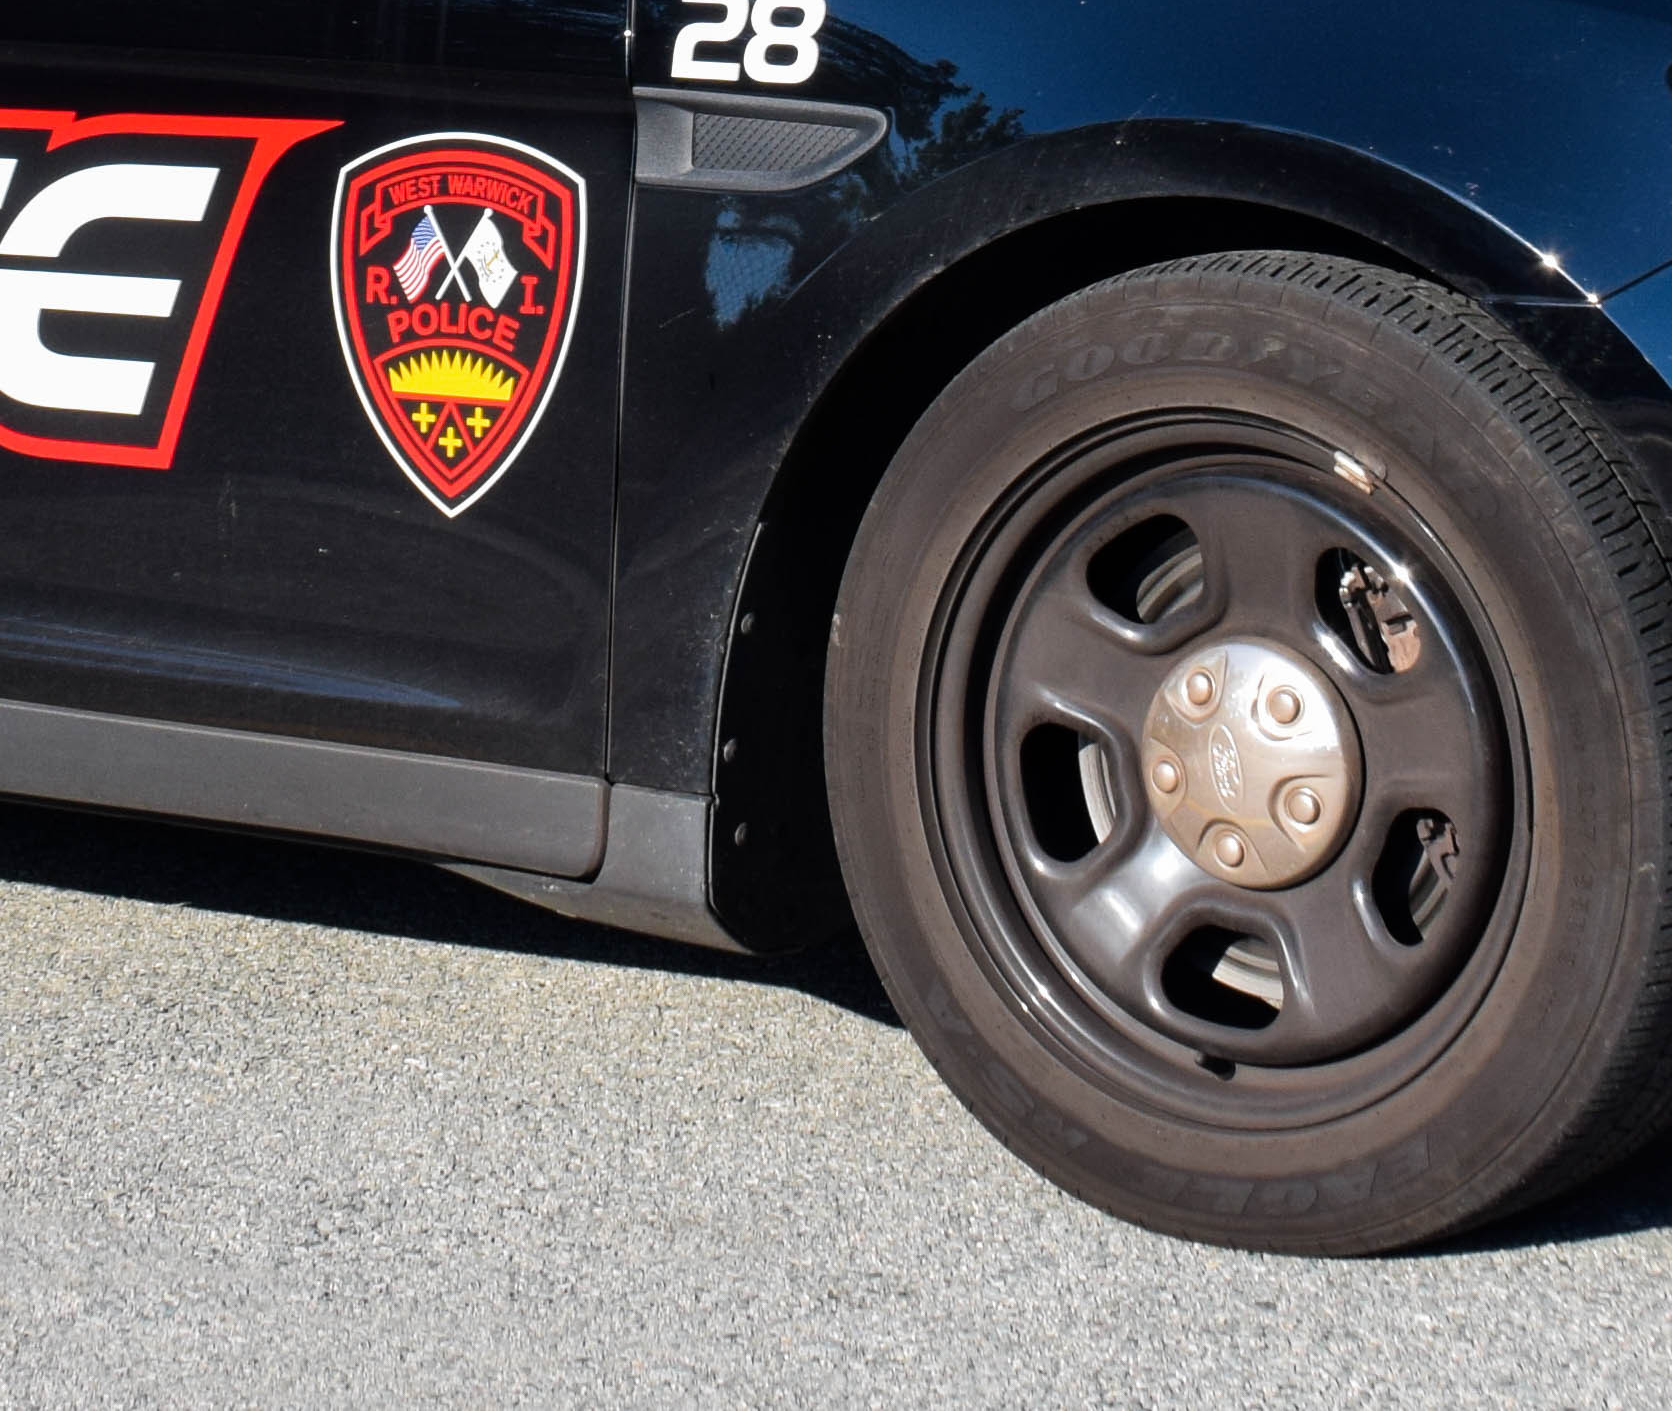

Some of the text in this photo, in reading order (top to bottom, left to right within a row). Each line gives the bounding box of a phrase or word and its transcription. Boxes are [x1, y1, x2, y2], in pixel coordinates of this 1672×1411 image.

[389, 174, 535, 215] WEST WARWICK
[366, 266, 399, 305] R.
[387, 303, 521, 352] POLICE
